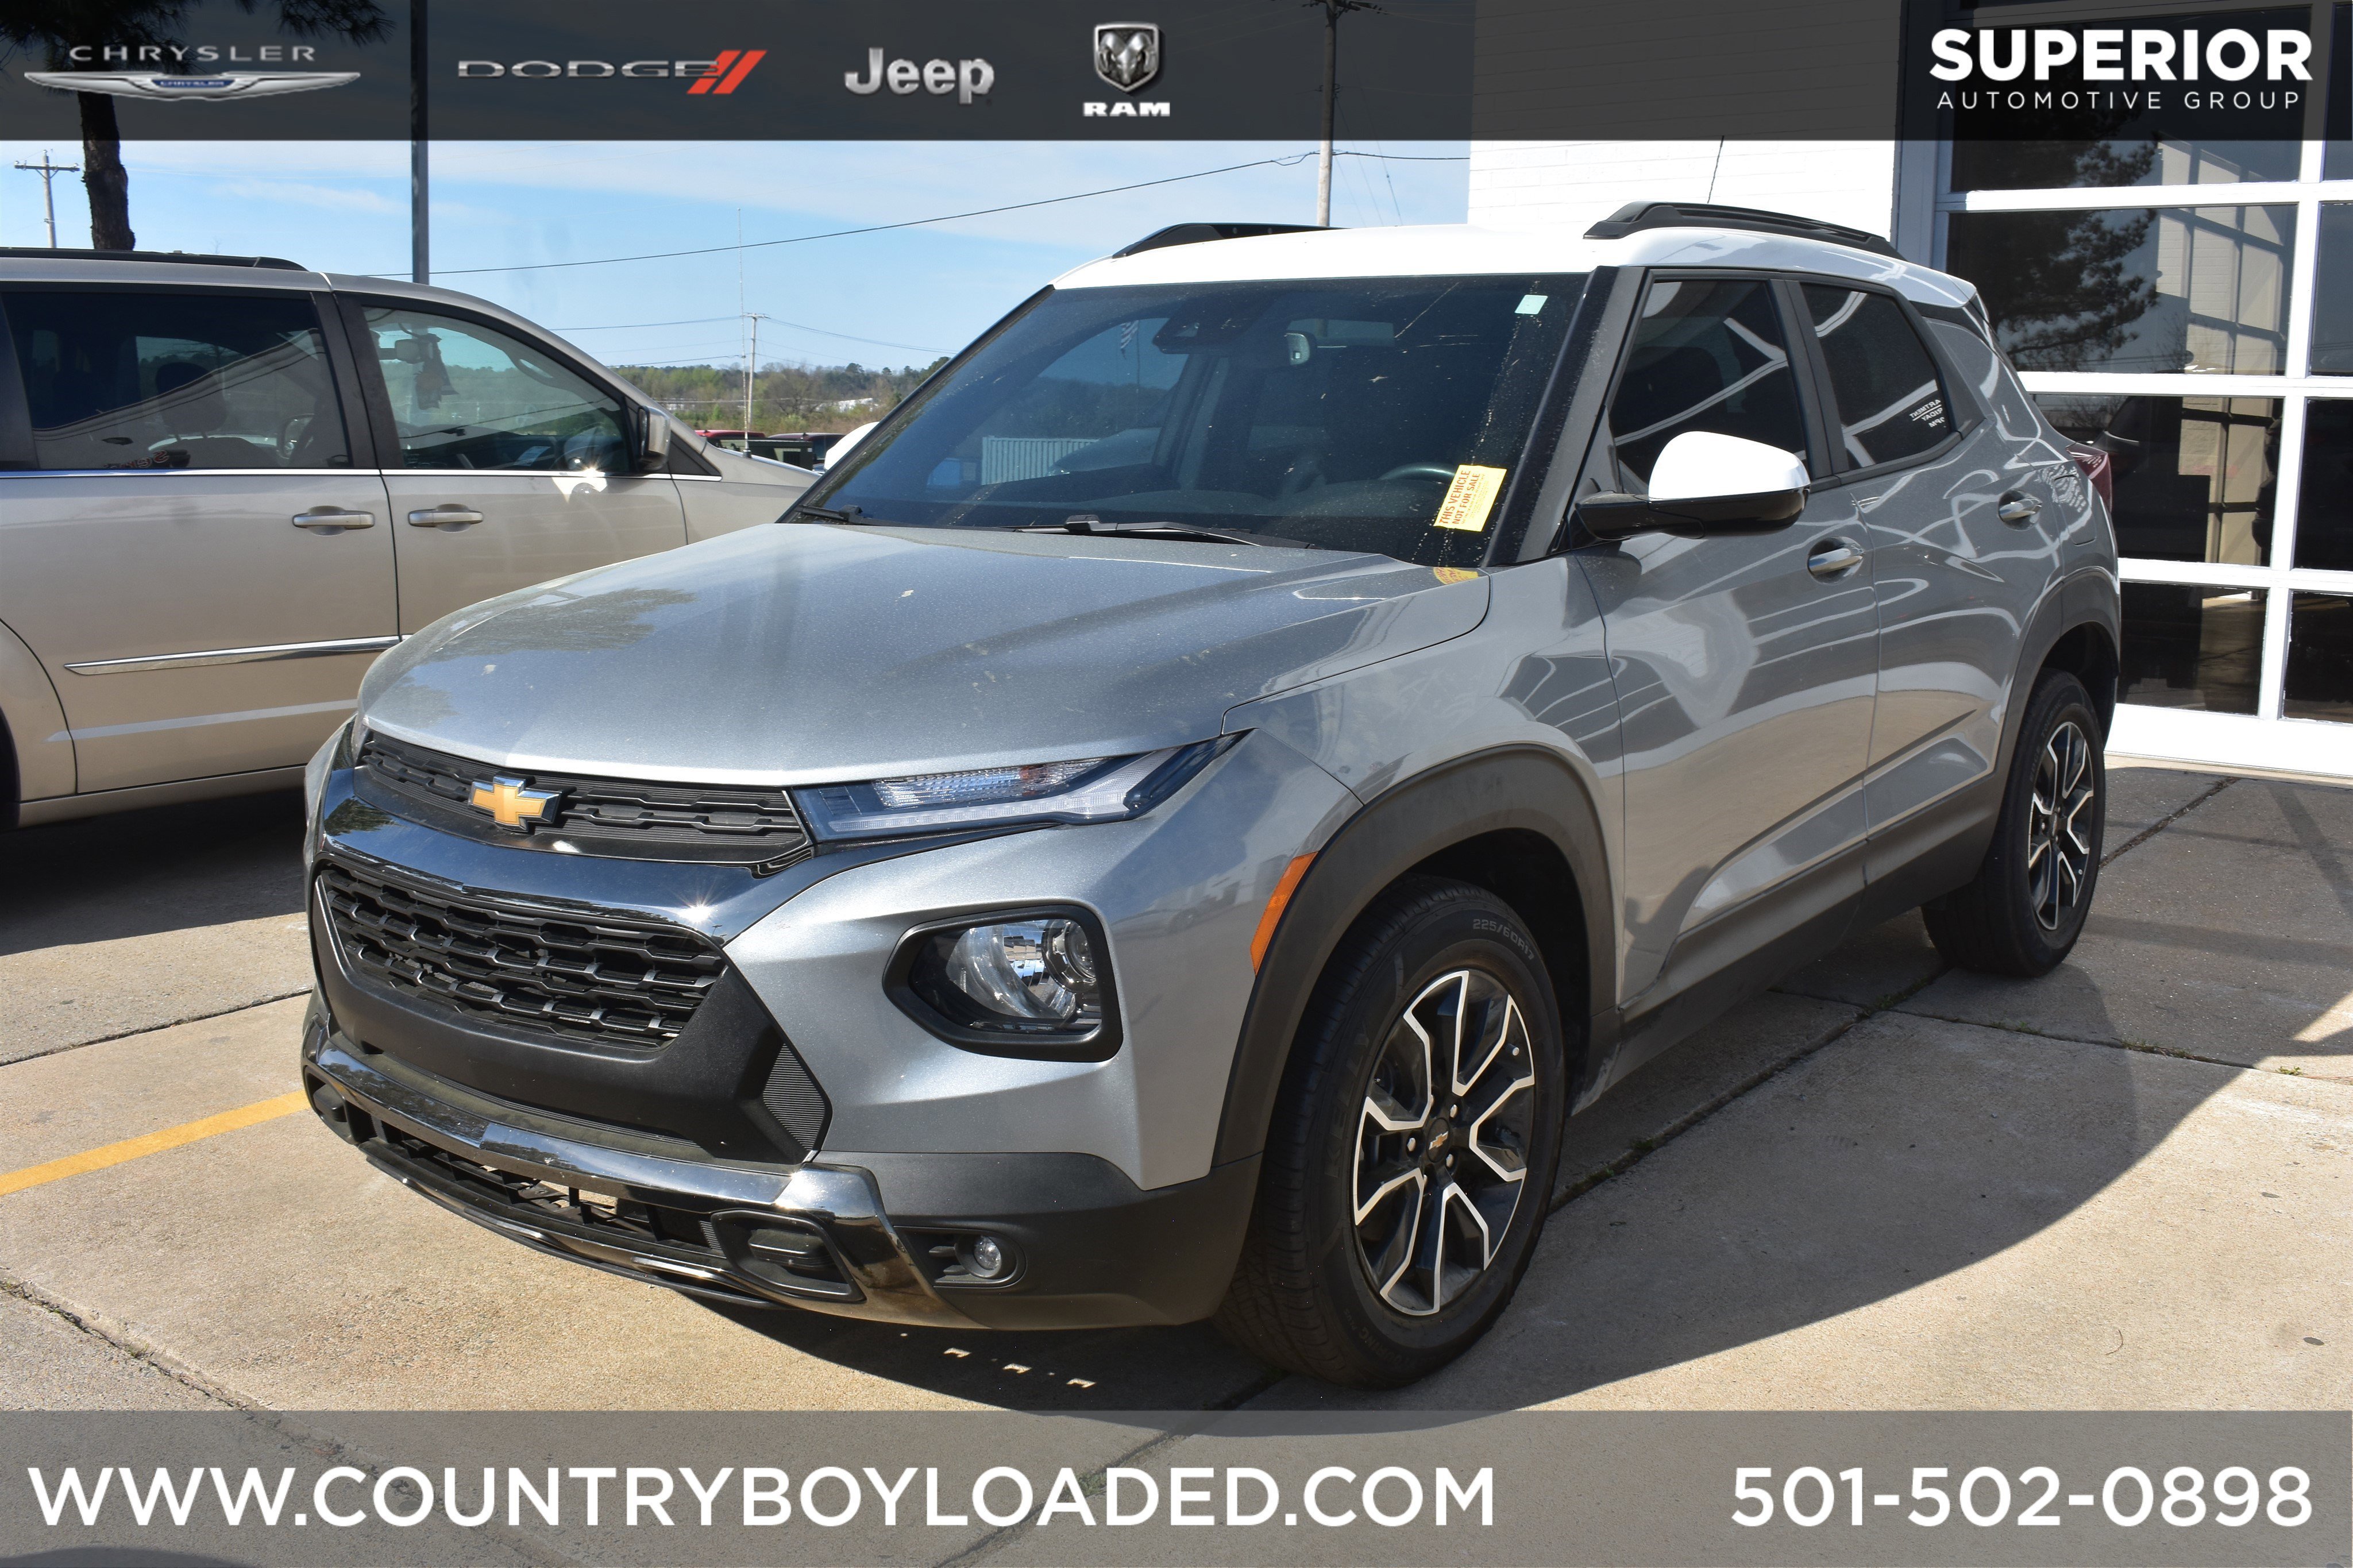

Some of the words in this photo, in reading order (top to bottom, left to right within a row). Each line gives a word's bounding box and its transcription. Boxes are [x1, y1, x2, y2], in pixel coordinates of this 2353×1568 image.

[1438, 506, 1452, 524] THIS
[1448, 470, 1471, 506] VEHICLE
[1452, 509, 1464, 524] NOT
[1460, 492, 1472, 509] FOR
[1470, 473, 1480, 492] SALE
[1472, 918, 1535, 960] 225/60R17
